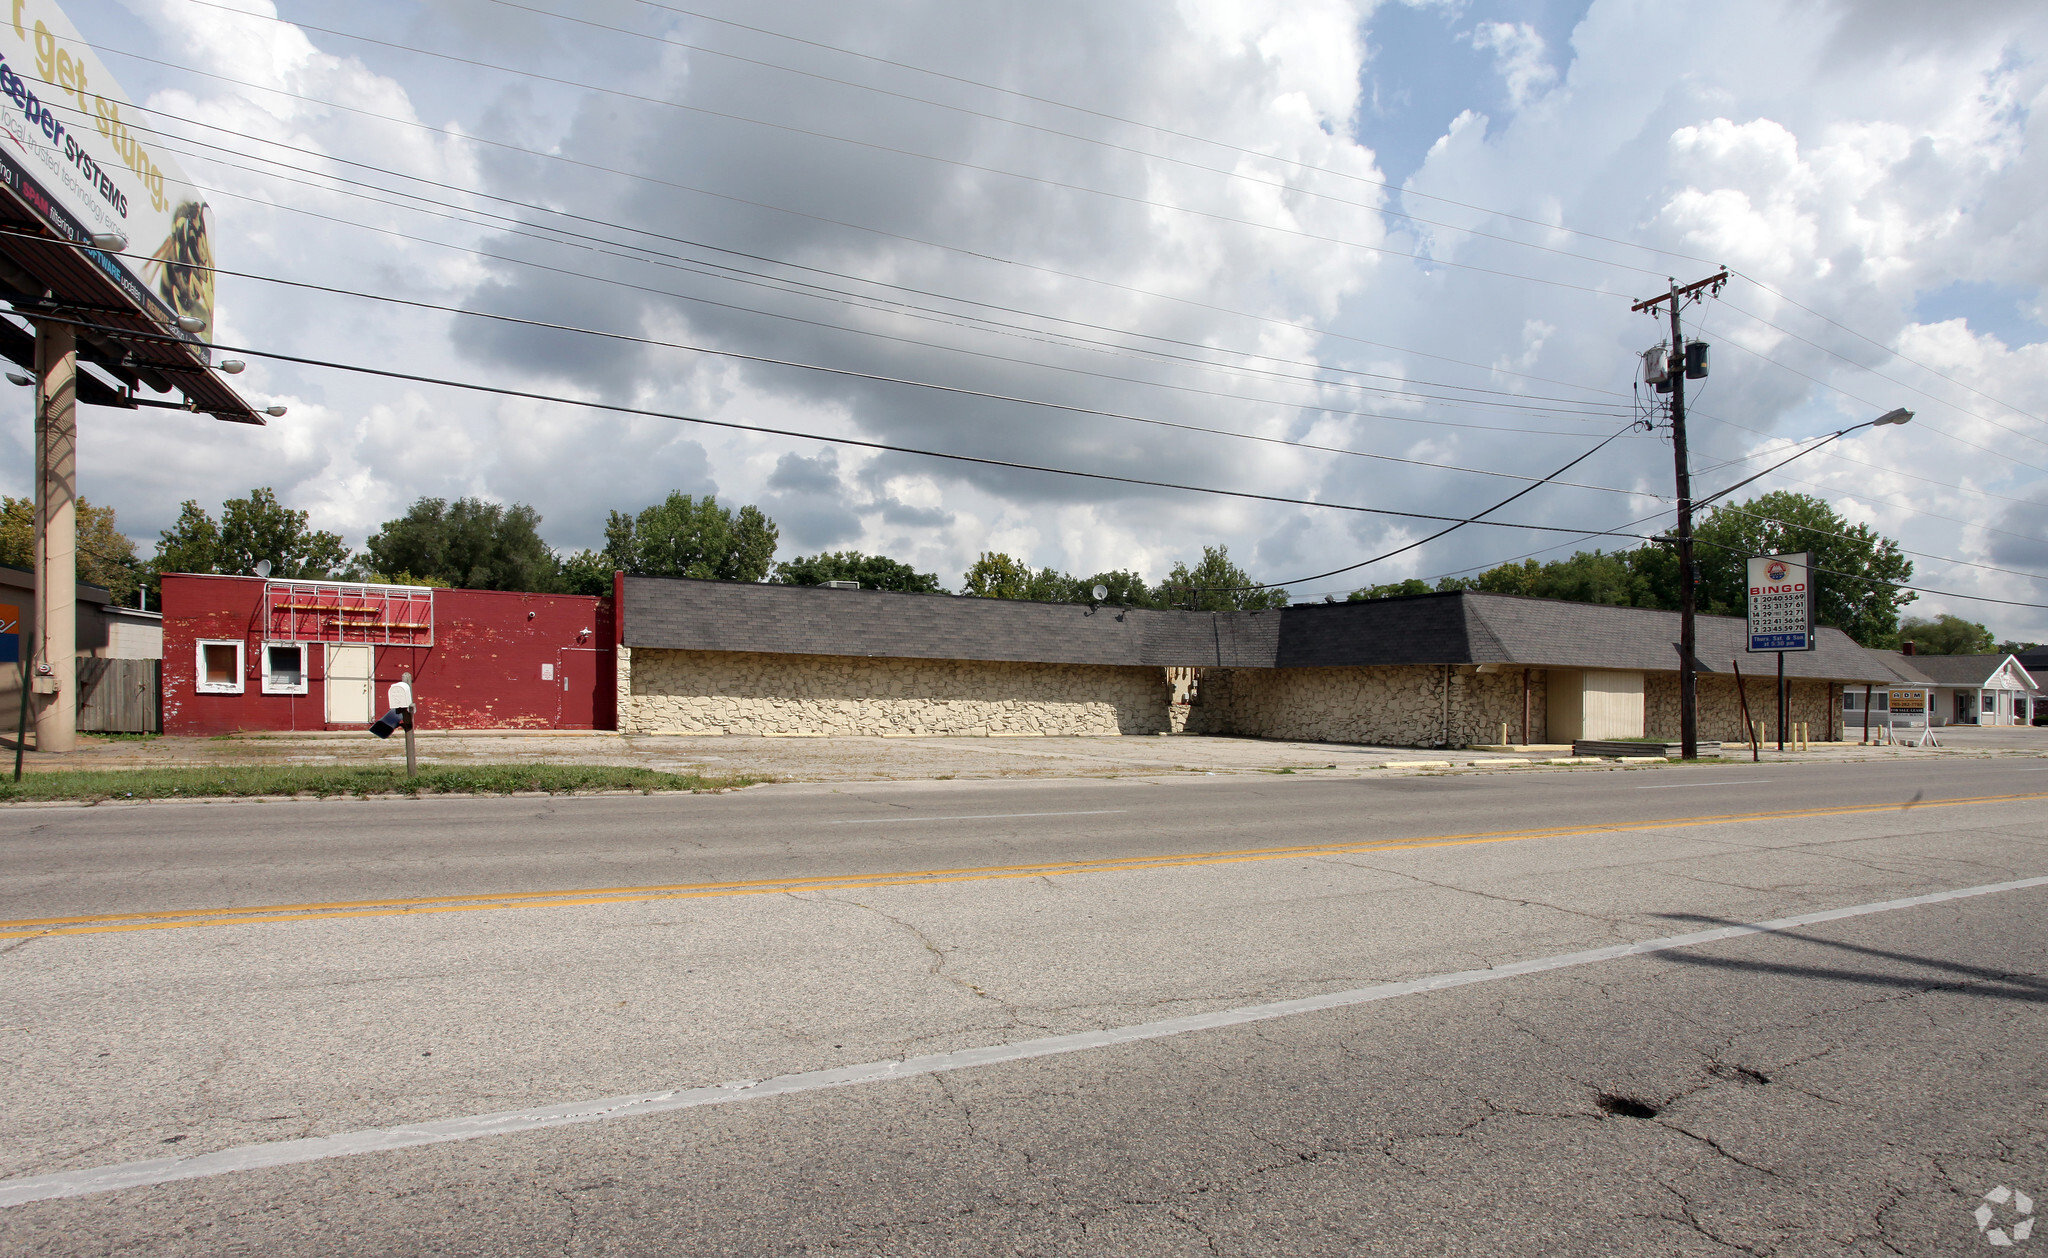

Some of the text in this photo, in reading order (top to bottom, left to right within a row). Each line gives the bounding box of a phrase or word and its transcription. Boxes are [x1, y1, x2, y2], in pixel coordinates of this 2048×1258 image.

[0, 52, 128, 219] eeper SYSTEMS
[2, 105, 26, 141] local
[28, 134, 61, 178] trusted
[61, 167, 104, 225] technology
[34, 19, 88, 115] get
[95, 94, 169, 213] stung.
[22, 181, 49, 215] SPAM
[49, 206, 74, 240] filtering
[1750, 584, 1805, 595] BINGO
